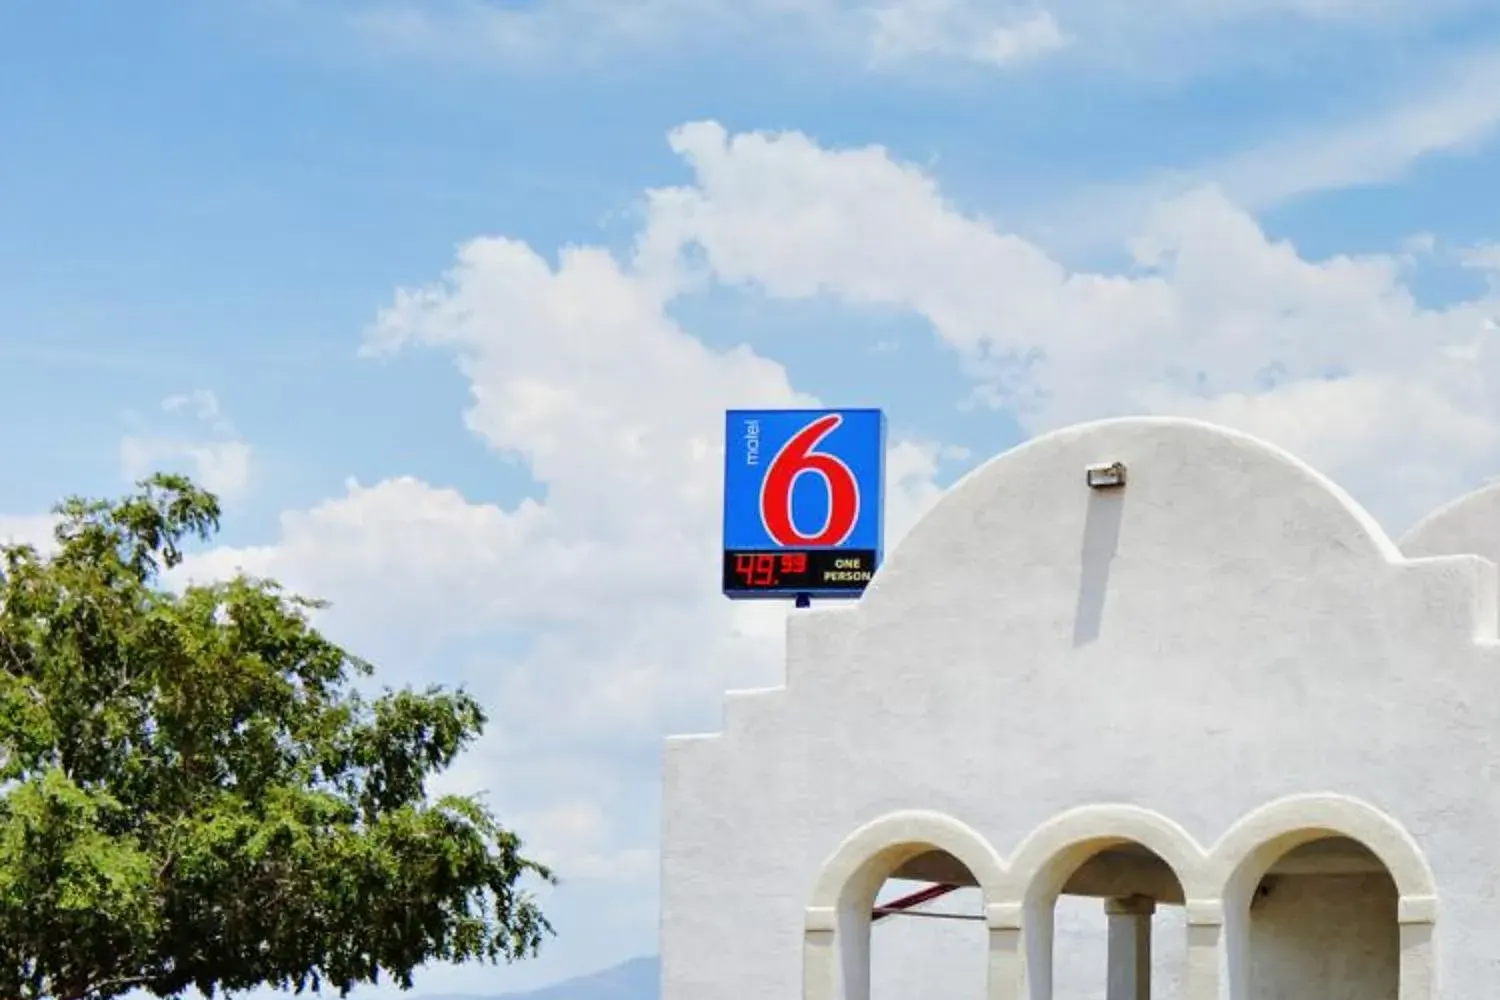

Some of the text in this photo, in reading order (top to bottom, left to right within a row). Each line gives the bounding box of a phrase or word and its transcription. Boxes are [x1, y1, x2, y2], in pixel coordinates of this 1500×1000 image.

[744, 413, 860, 547] motel 6
[835, 558, 861, 569] ONE
[823, 571, 871, 581] PERSON
